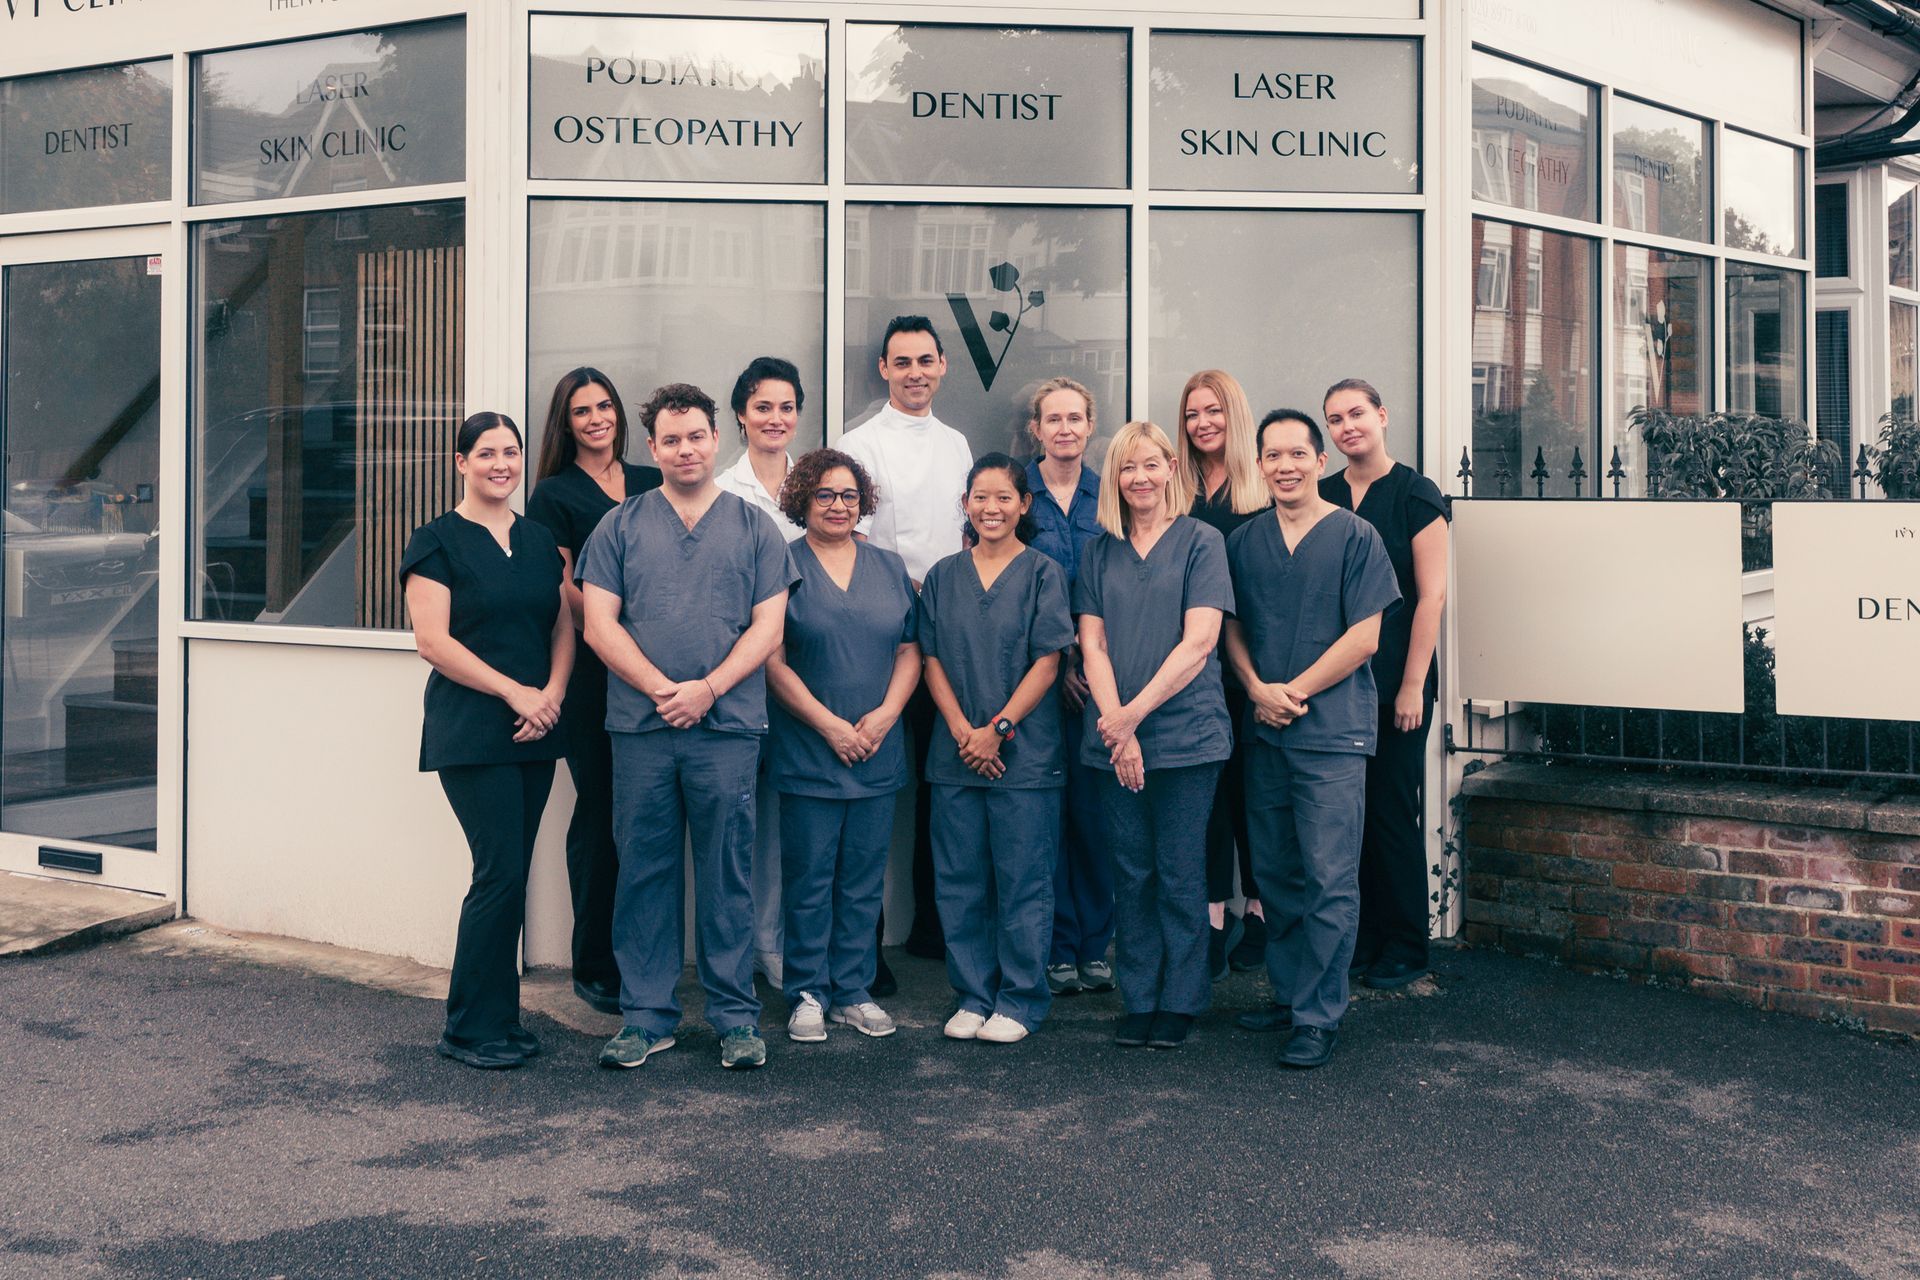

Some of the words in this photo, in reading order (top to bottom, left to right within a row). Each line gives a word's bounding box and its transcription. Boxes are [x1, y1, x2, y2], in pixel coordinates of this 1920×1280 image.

[297, 71, 369, 104] LASER
[1234, 73, 1336, 99] LASER
[912, 91, 1062, 120] DENTIST
[45, 123, 133, 154] DENTIST
[260, 134, 313, 165] SKIN
[322, 124, 406, 158] CLINIC
[554, 115, 802, 147] OSTEOPATHY
[1181, 128, 1258, 156] SKIN
[1272, 130, 1386, 157] CLINIC
[1634, 154, 1677, 184] DENTIST
[1896, 527, 1915, 538] IVY
[1859, 597, 1920, 620] DEN
